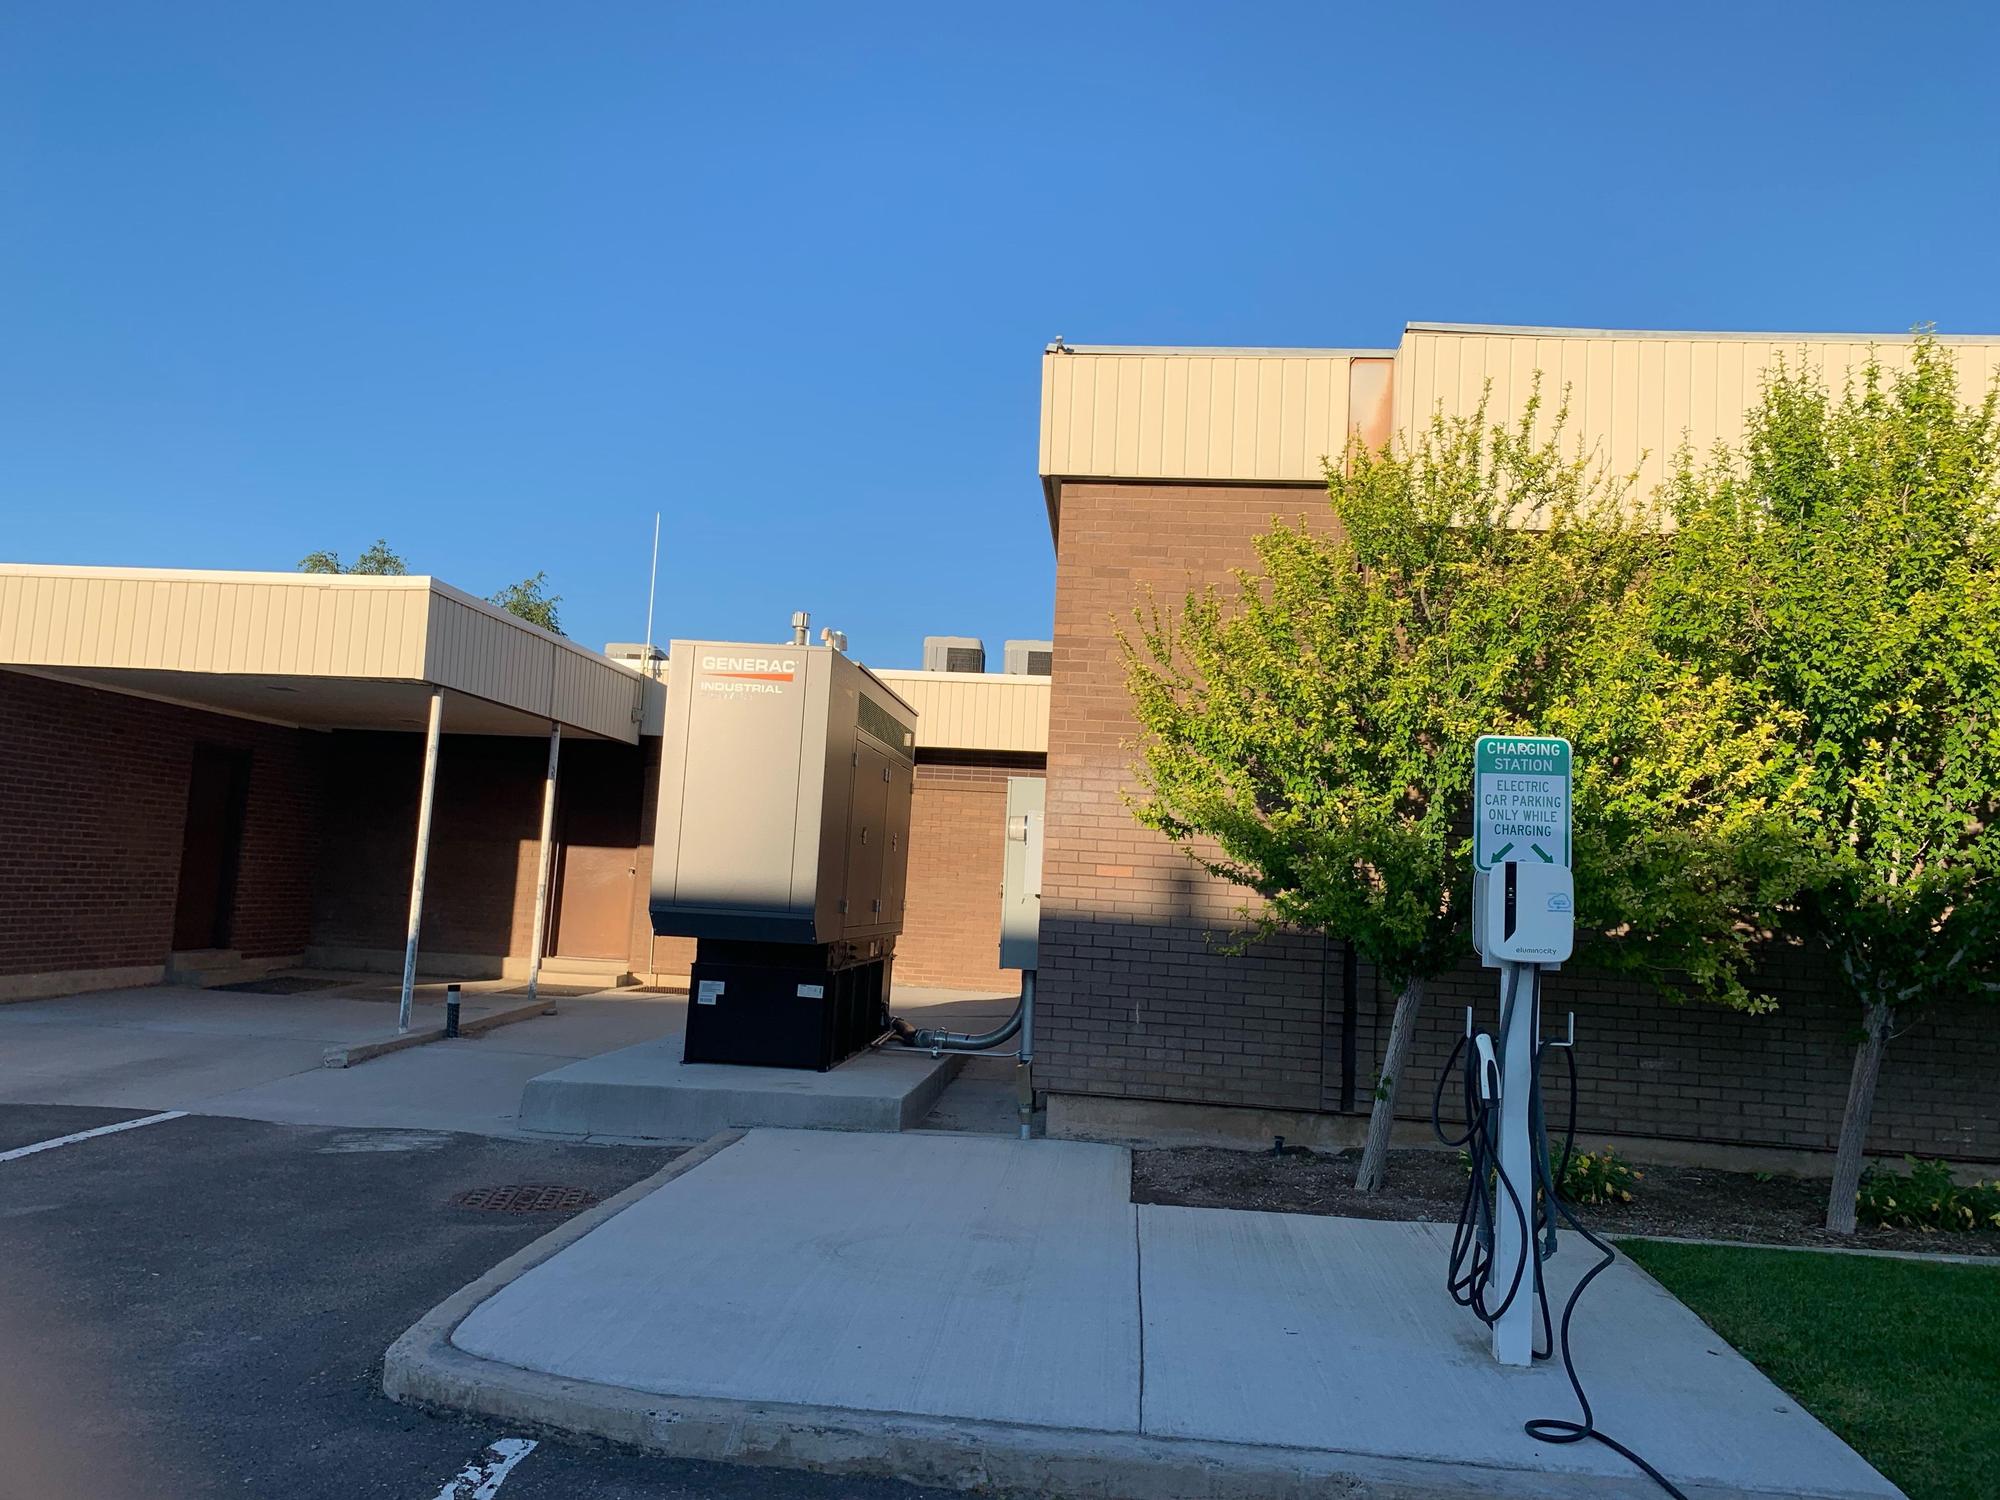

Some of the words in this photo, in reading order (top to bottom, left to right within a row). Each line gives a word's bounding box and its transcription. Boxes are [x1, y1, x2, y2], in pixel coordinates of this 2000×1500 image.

[702, 656, 796, 673] GENERAC
[700, 681, 784, 694] INDUSTRIAL
[1487, 742, 1561, 757] CHARGING
[1494, 758, 1553, 772] STATION
[1497, 780, 1549, 793] ELECTRIC
[1485, 794, 1507, 806] CAR
[1512, 795, 1561, 808] PARKING
[1488, 809, 1518, 821] ONLY
[1523, 810, 1558, 823] WHILE
[1494, 824, 1552, 837] CHARGING
[1515, 946, 1557, 956] eluminocity
